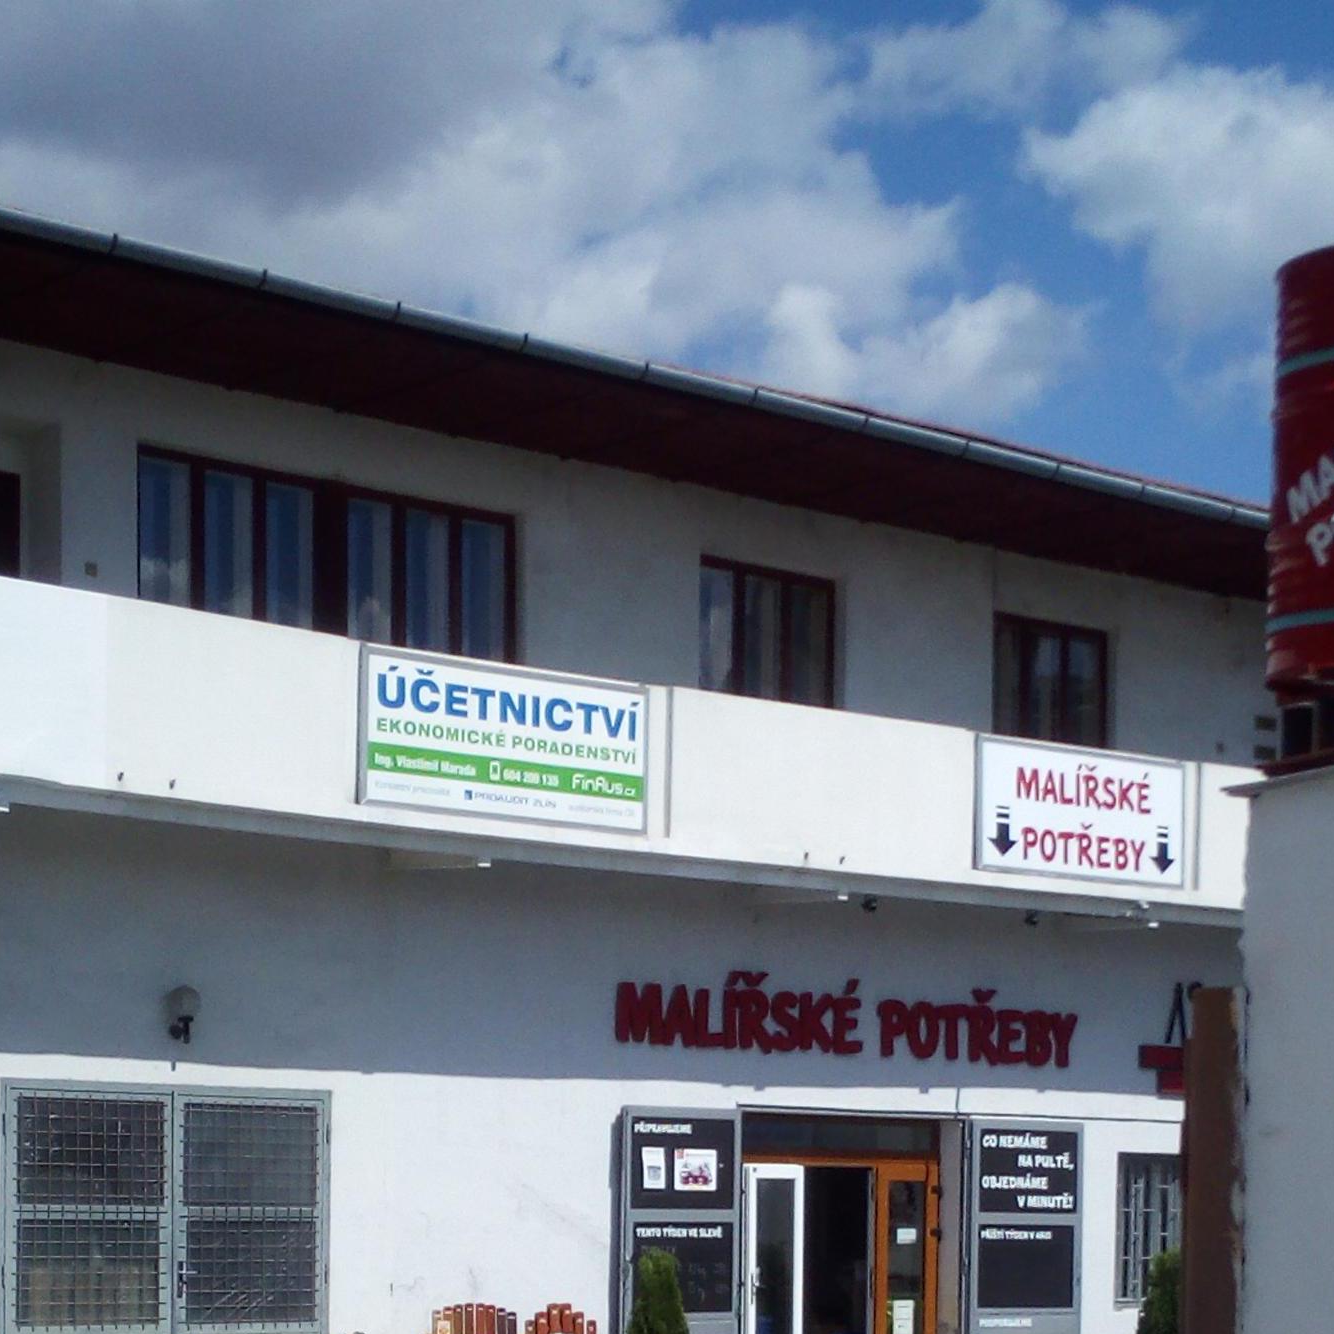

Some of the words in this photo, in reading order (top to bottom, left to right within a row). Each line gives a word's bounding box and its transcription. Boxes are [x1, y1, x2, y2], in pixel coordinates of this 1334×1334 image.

[377, 665, 639, 742] ÚČETNICTVÍ
[376, 717, 506, 748] EKONOMICKÉ
[511, 735, 637, 765] PORADENSTVÍ
[1017, 763, 1152, 815] MALÍŘSKÉ
[1020, 823, 1146, 872] POTŘEBY
[615, 970, 864, 1056] MALÍŘSKÉ
[877, 988, 1078, 1067] POTŘEBY
[982, 1135, 997, 1147] CO
[999, 1132, 1048, 1149] NEMÁME
[1018, 1154, 1033, 1168] NA
[981, 1173, 1048, 1189] OBJEDNÁME
[1017, 1195, 1025, 1208] V
